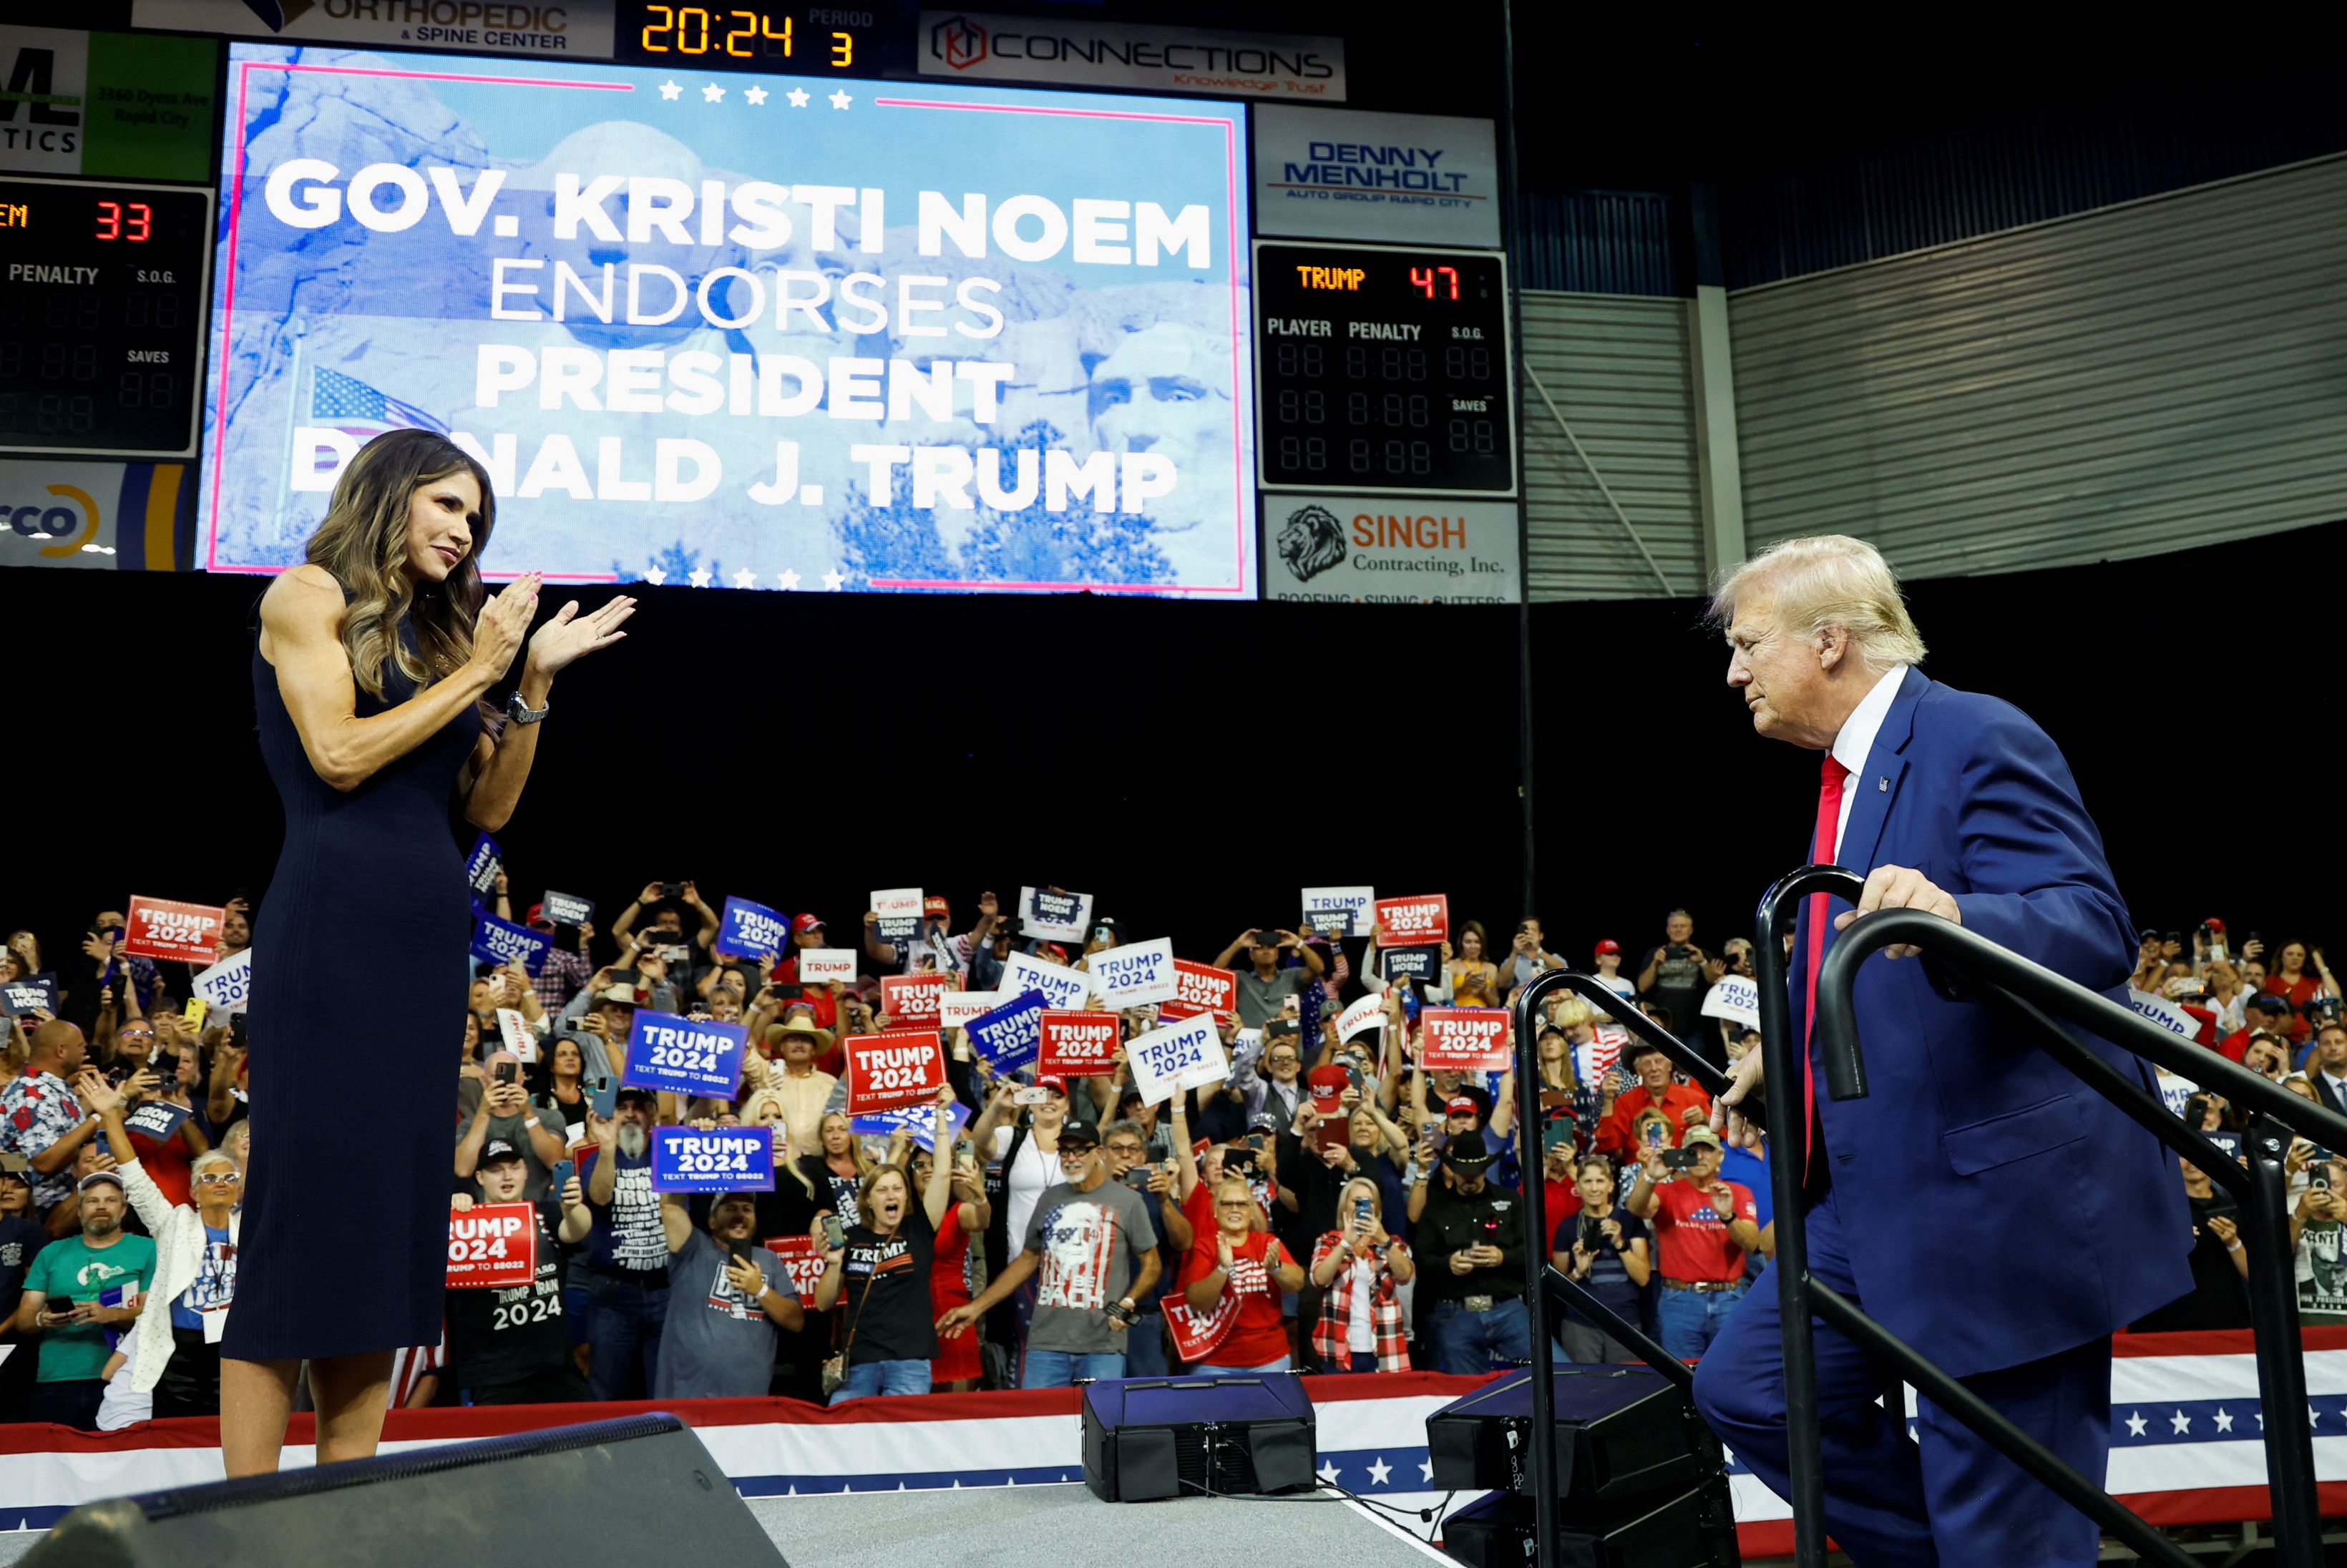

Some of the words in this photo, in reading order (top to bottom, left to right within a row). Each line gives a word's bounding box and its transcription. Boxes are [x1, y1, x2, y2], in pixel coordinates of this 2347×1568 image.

[323, 0, 567, 34] ORTHOPEDIC
[809, 8, 874, 27] PERIOD
[417, 26, 477, 45] SPINE
[484, 31, 567, 49] CENTER
[643, 5, 791, 57] 20:24
[831, 32, 852, 67] 3
[992, 33, 1333, 79] CONNECTIONS
[1174, 74, 1278, 90] Knowledge
[1284, 80, 1325, 94] Trust
[182, 93, 209, 106] Ave
[114, 109, 157, 124] Rapid
[160, 112, 189, 127] City
[1309, 141, 1444, 168] DENNY
[1284, 162, 1468, 192] MENHOLT
[1287, 189, 1329, 200] AUTO
[1333, 191, 1385, 202] GROUP
[1390, 195, 1435, 206] RAPID
[1439, 197, 1472, 208] CITY
[96, 201, 152, 241] 33
[265, 158, 518, 237] GOV.
[554, 172, 884, 253] KRISTI
[918, 191, 1210, 268] NOEM
[9, 263, 99, 285] PENALTY
[137, 270, 177, 283] S.O.G.
[1297, 265, 1365, 290] TRUMP
[1410, 267, 1459, 300] 47
[492, 258, 1003, 339] ENDORSES
[1268, 318, 1332, 338] PLAYER
[1349, 322, 1422, 341] PENALTY
[1452, 327, 1485, 340] S.O.G.
[127, 351, 170, 363] SAVES
[476, 343, 1014, 423] PRESIDENT
[1452, 399, 1487, 412] SAVES
[291, 427, 722, 501] DNALD
[747, 441, 823, 506] J.
[851, 444, 1177, 514] TRUMP
[1352, 513, 1466, 549] SINGH
[1353, 554, 1465, 577] Contracting,
[1470, 556, 1505, 572] Inc.
[550, 896, 590, 913] TRUMP
[1038, 894, 1075, 906] TRUMP
[1039, 903, 1070, 915] NOEM
[1312, 897, 1367, 908] TRUMP
[138, 908, 215, 930] TRUMP
[550, 906, 586, 922] NOEM
[733, 908, 786, 937] TRUMP
[1311, 913, 1349, 923] TRUMP
[1380, 903, 1440, 920] TRUMP
[145, 924, 203, 944] 2024
[877, 918, 917, 928] TRUMP
[881, 927, 915, 937] NOEM
[1390, 916, 1433, 931] 2024
[484, 921, 543, 951] TRUMP
[738, 925, 780, 949] 2024
[486, 937, 530, 961] 2024
[1390, 953, 1428, 964] TRUMP
[807, 962, 851, 972] TRUMP
[1098, 953, 1163, 976] TRUMP
[1392, 963, 1425, 973] NOEM
[204, 965, 250, 994] TRUM
[1017, 966, 1081, 995] TRUMP
[1108, 969, 1156, 989] 2024
[1174, 969, 1231, 994] TRUMP
[4, 988, 48, 999] TRUMP
[889, 984, 950, 1001] TRUM
[1020, 984, 1067, 1008] 224
[1179, 986, 1223, 1008] 2024
[1723, 994, 1759, 1009] 202
[947, 1006, 992, 1016] TRUMP
[977, 1006, 1043, 1044] TRUMP
[1048, 1024, 1113, 1042] TRUMP
[1430, 1020, 1503, 1037] TRUMP
[643, 1025, 734, 1055] TRUMP
[992, 1023, 1040, 1055] 2024
[1055, 1041, 1105, 1057] 2024
[1138, 1029, 1207, 1065] TRUMP
[1439, 1037, 1492, 1052] 2024
[650, 1046, 717, 1072] 2024
[855, 1046, 935, 1071] TRUMP
[1153, 1048, 1202, 1077] 2024
[635, 1064, 656, 1074] TEXT
[657, 1067, 688, 1078] TRUMP
[689, 1072, 701, 1080] TO
[869, 1066, 927, 1090] 2024
[857, 1093, 877, 1102] TEXT
[877, 1090, 904, 1099] TRUMP
[664, 1137, 761, 1155] TRUMP
[678, 1154, 749, 1172] 2024
[448, 1238, 508, 1261] 024
[491, 1285, 530, 1304] TRUMP
[535, 1278, 559, 1296] TRAIN
[493, 1295, 562, 1331] 2024
